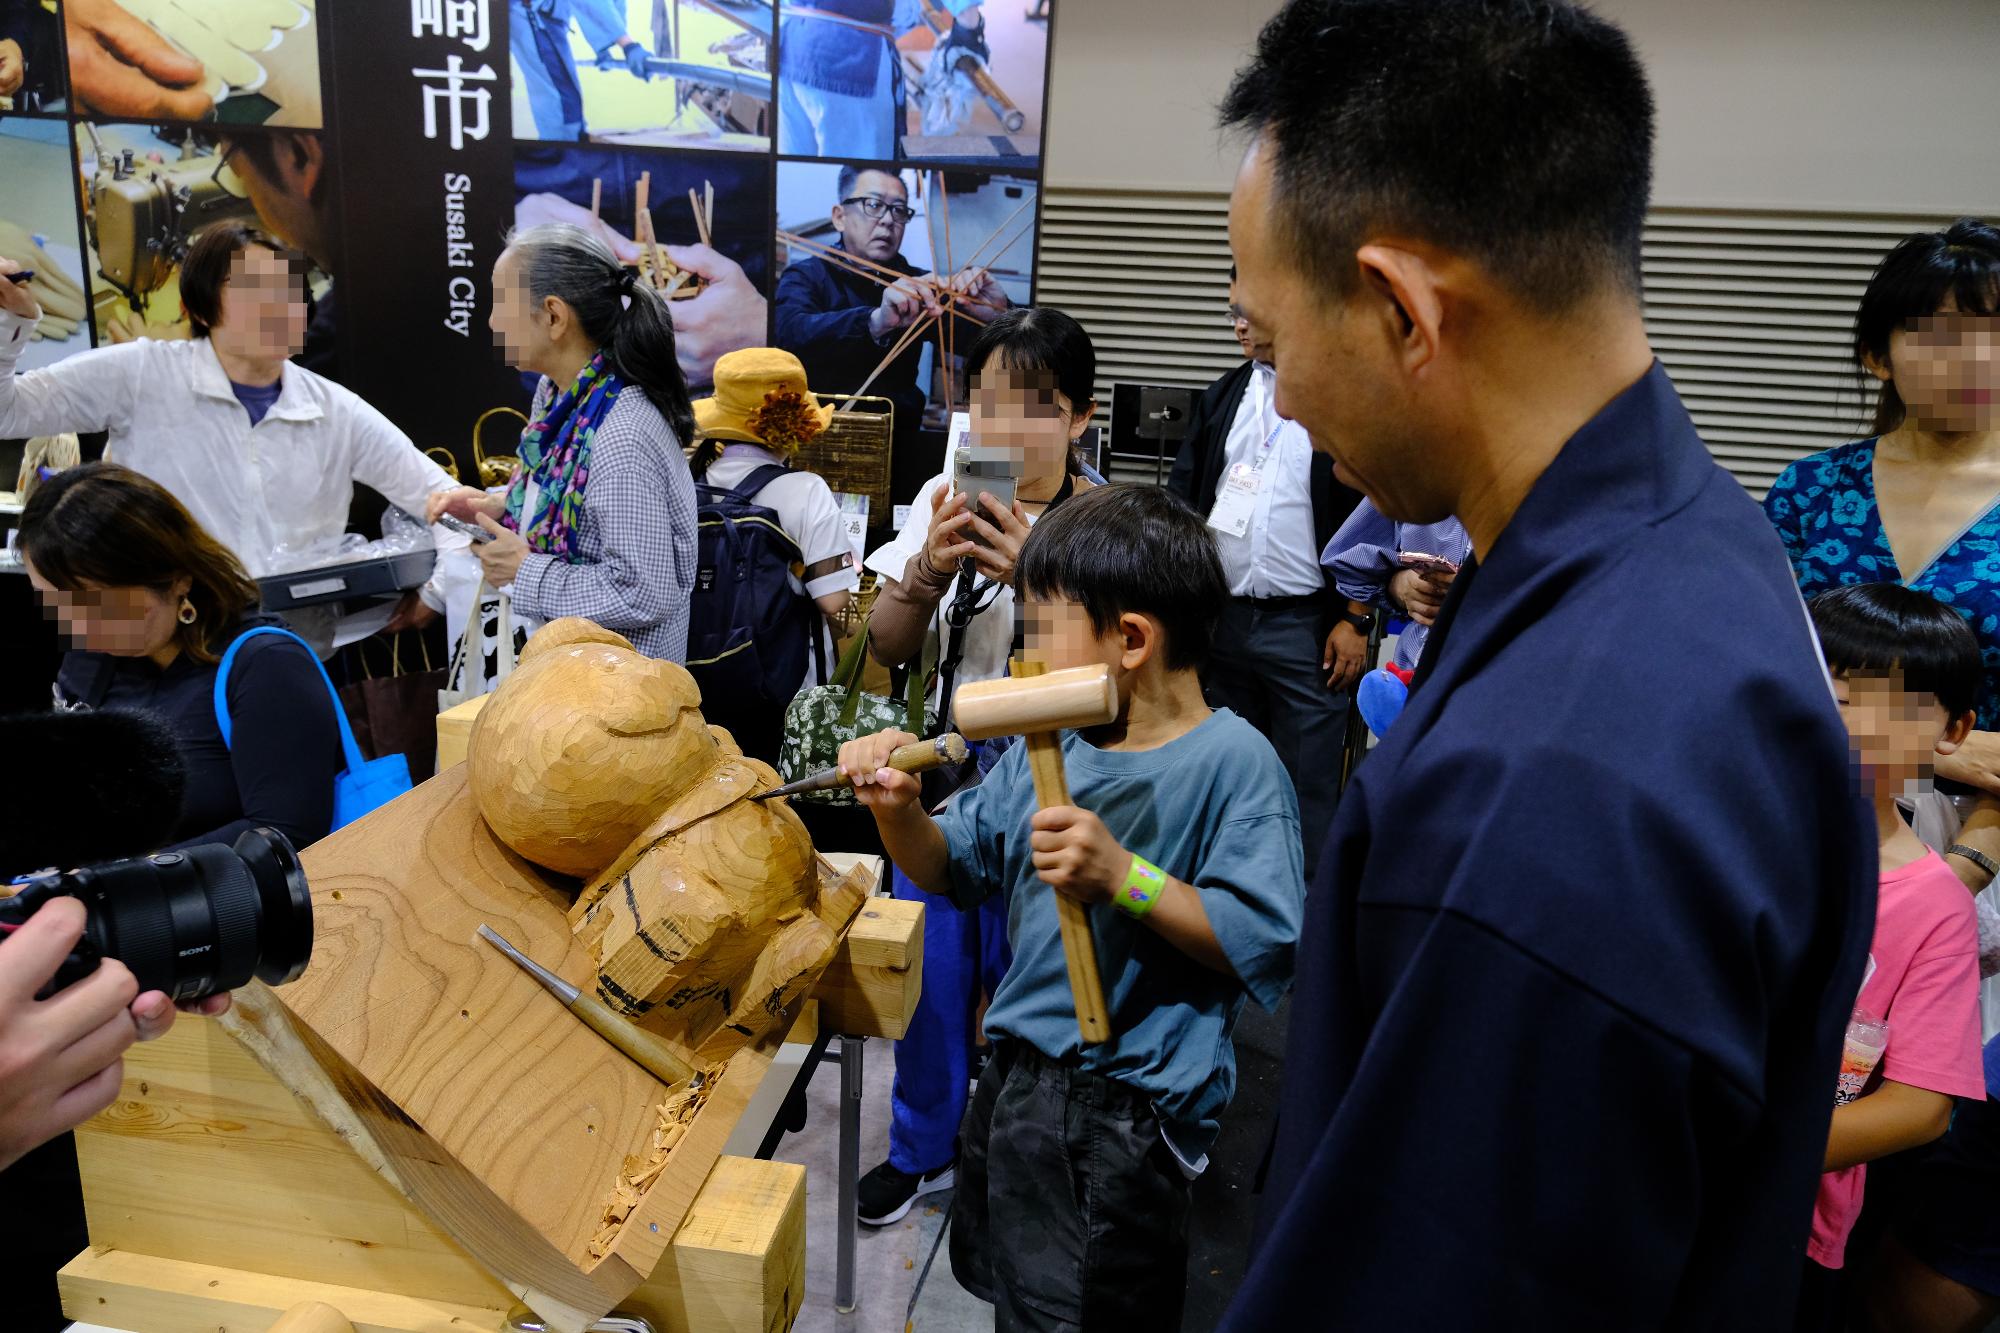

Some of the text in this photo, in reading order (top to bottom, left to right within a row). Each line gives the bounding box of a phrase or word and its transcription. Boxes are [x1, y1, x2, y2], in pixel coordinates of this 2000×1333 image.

[444, 172, 476, 338] Susaki City
[179, 945, 212, 957] SONY
